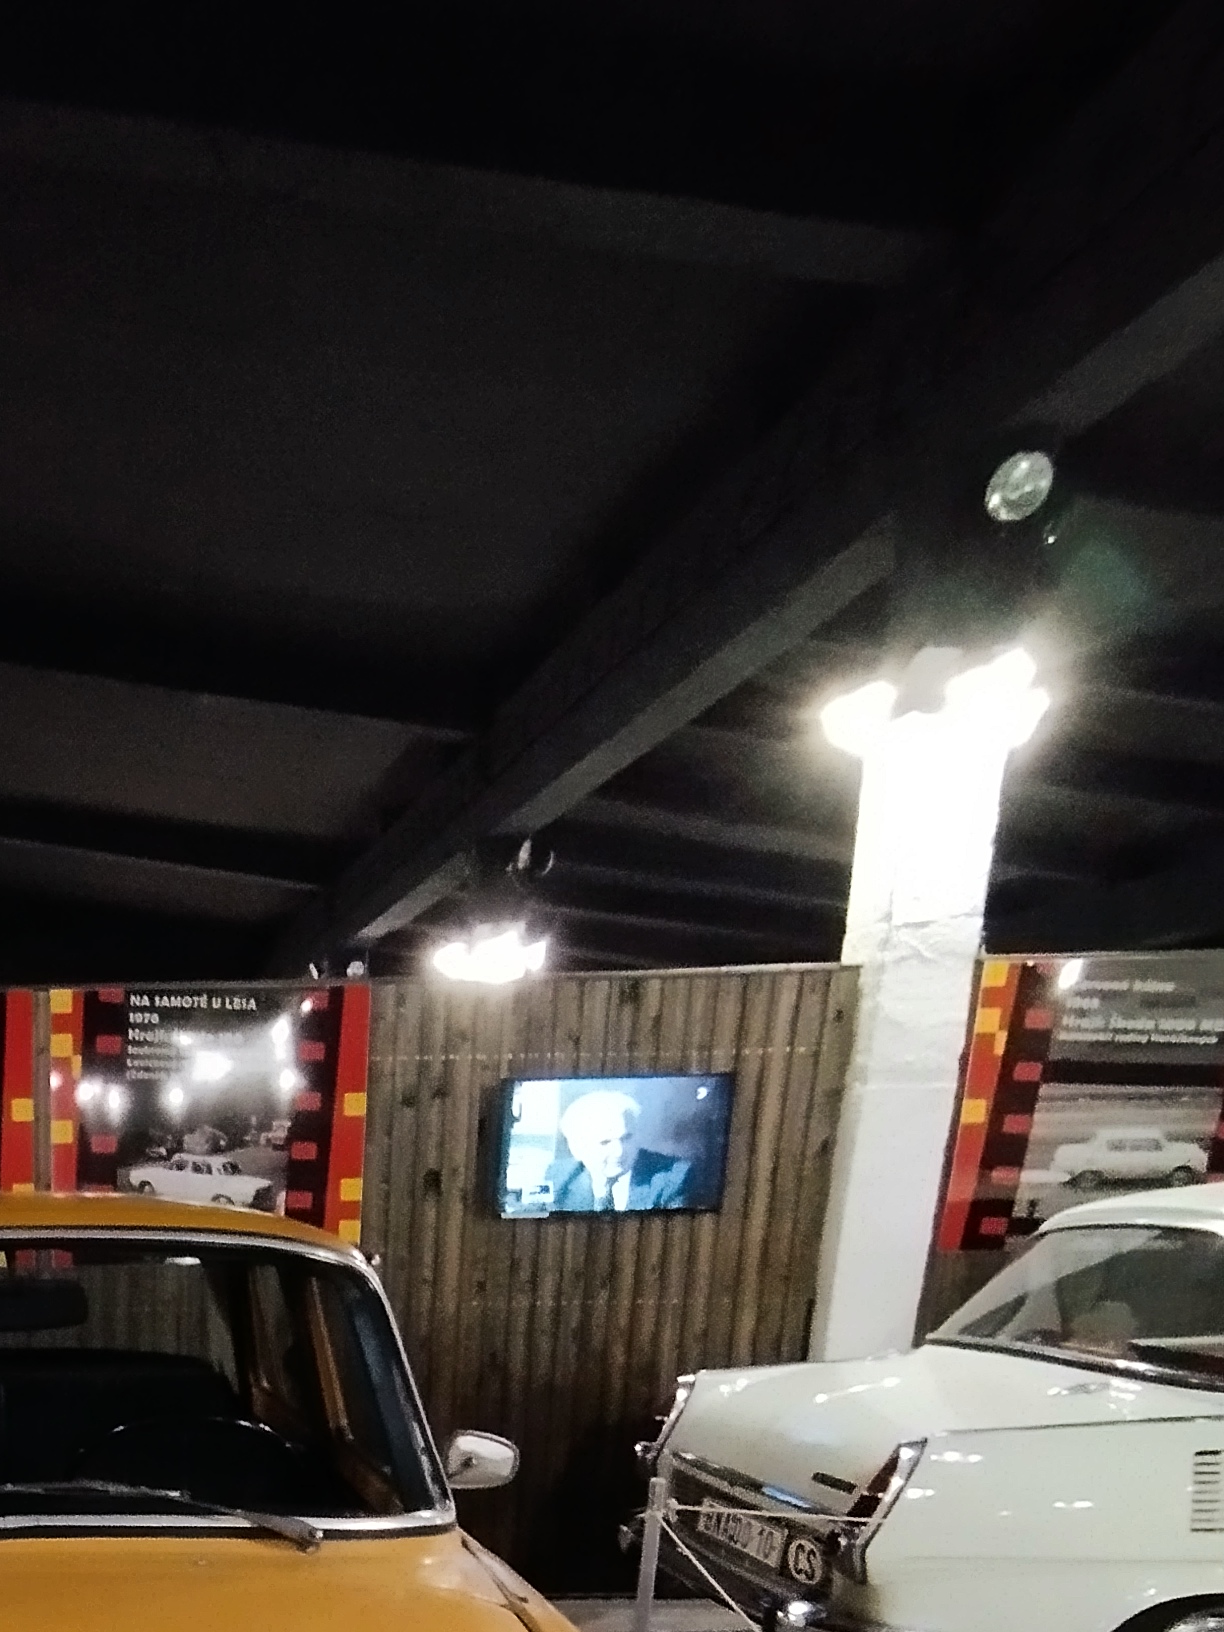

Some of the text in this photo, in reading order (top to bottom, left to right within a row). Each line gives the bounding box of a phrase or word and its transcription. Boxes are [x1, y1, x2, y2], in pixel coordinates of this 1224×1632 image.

[130, 994, 150, 1007] NA
[212, 996, 222, 1008] U
[794, 1542, 818, 1582] CS
